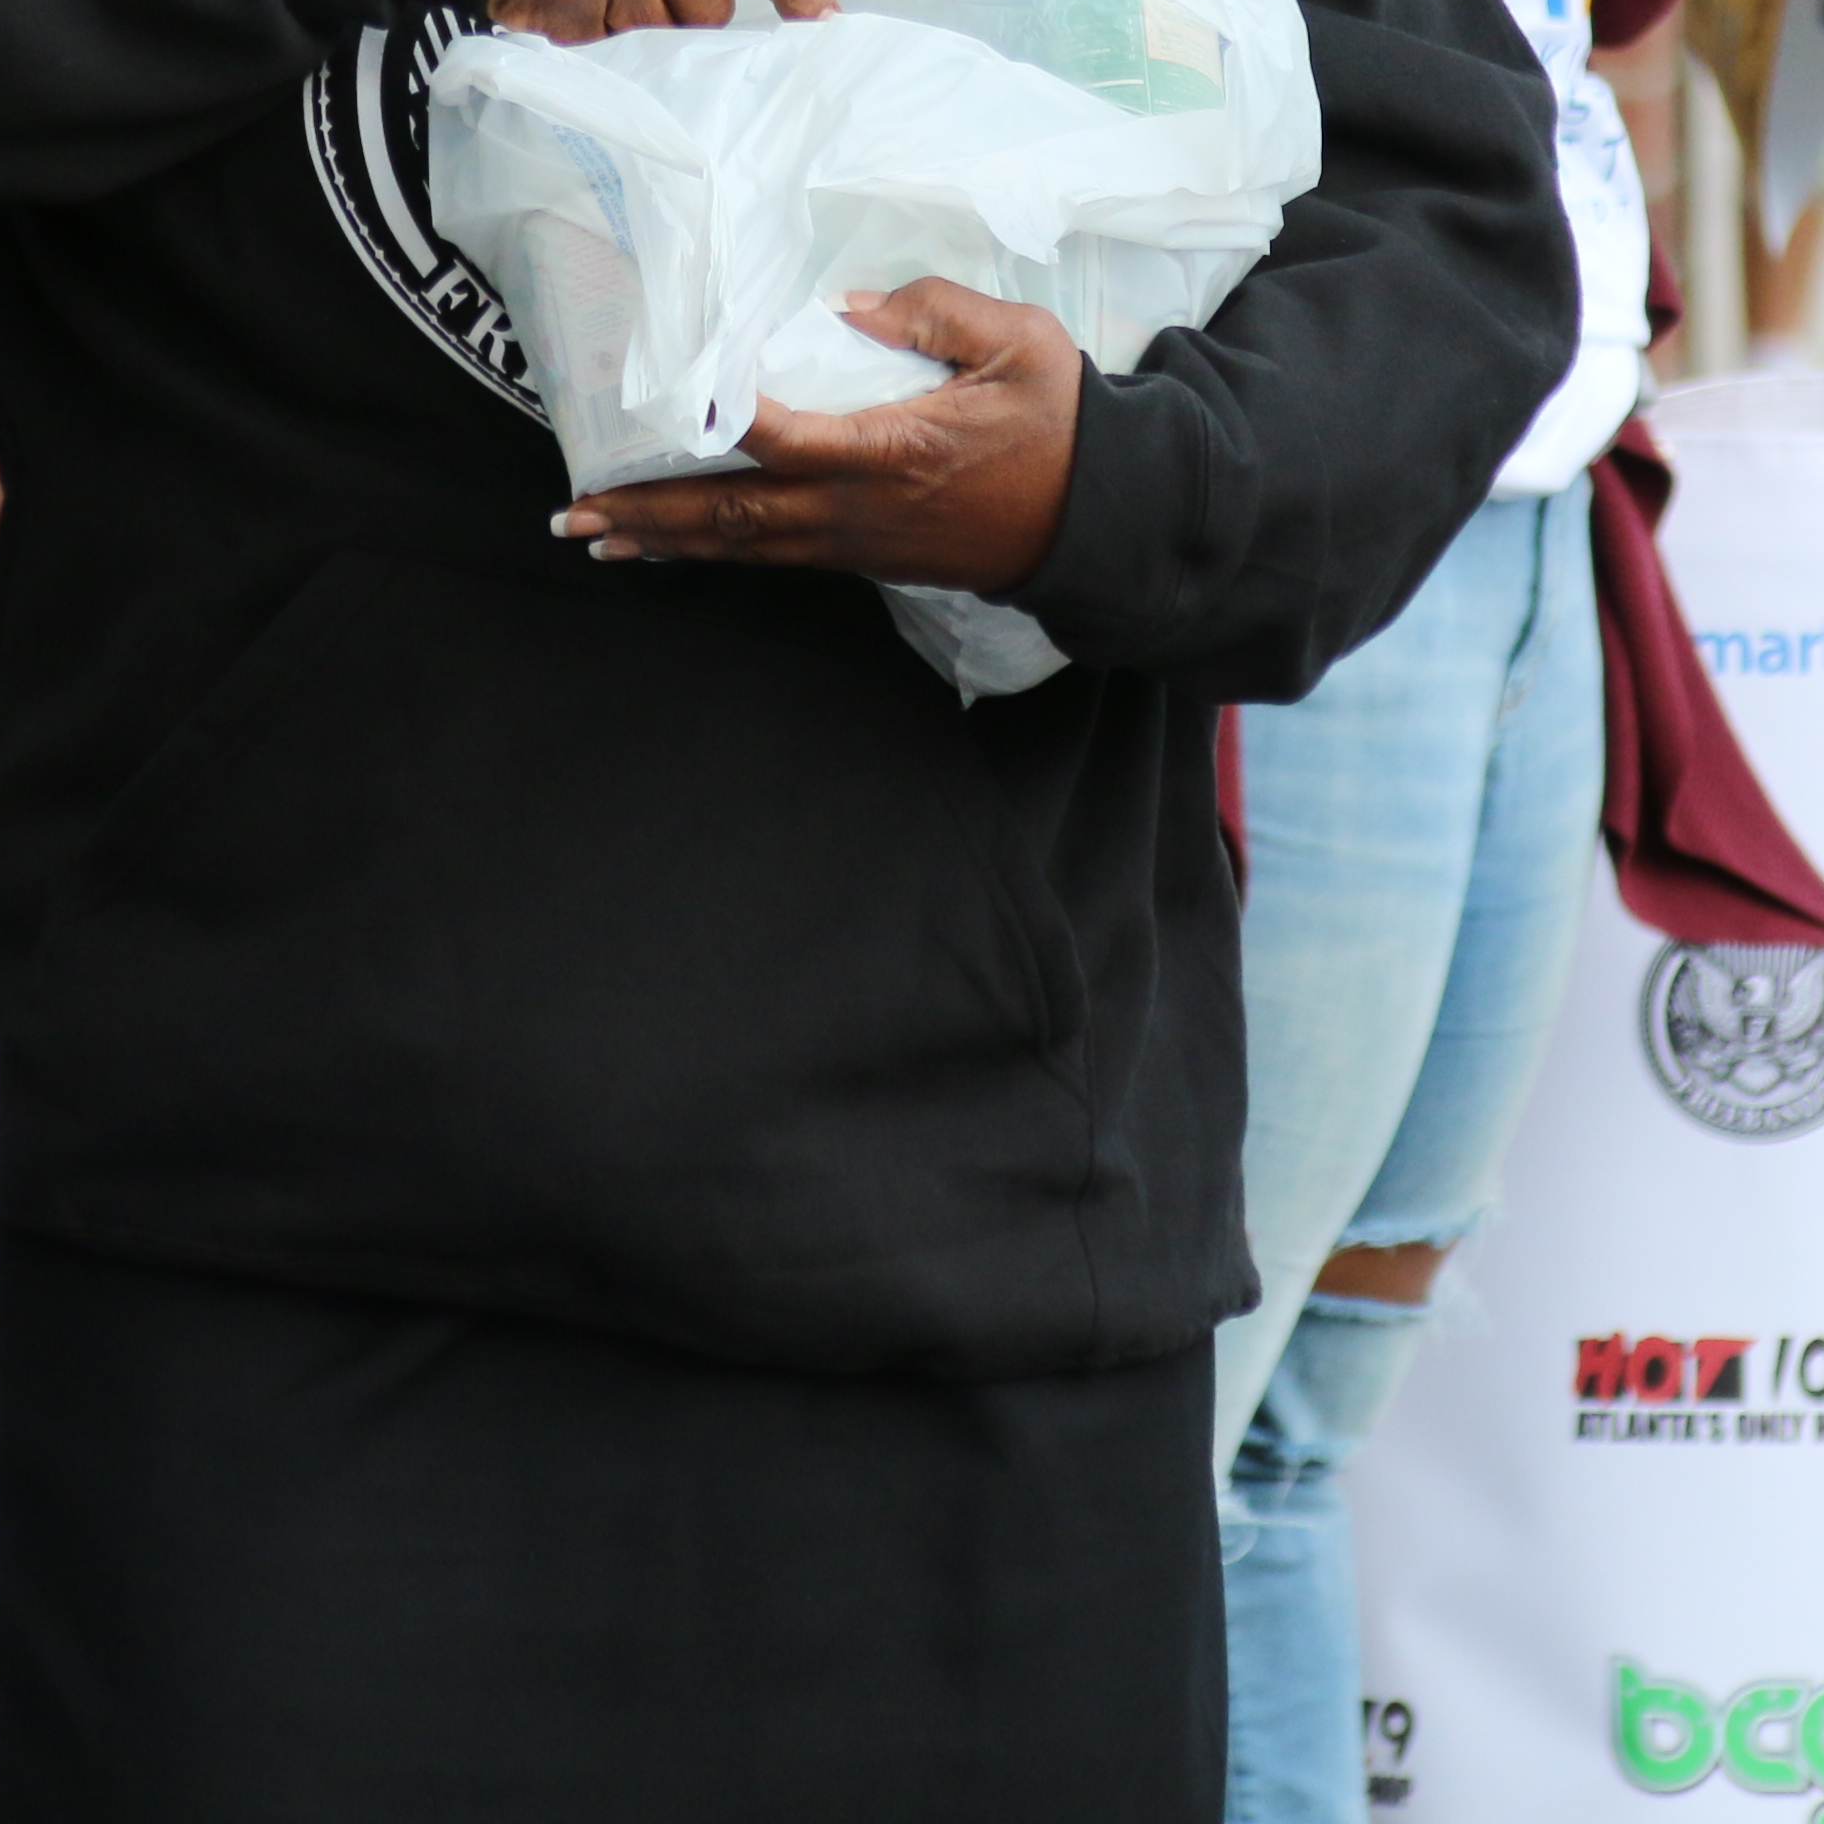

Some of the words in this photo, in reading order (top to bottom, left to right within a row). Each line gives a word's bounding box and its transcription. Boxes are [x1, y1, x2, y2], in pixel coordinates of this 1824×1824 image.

[1573, 1332, 1756, 1403] HOT
[1576, 1411, 1724, 1441] ATLANTA'S
[1736, 1411, 1804, 1441] ONLY
